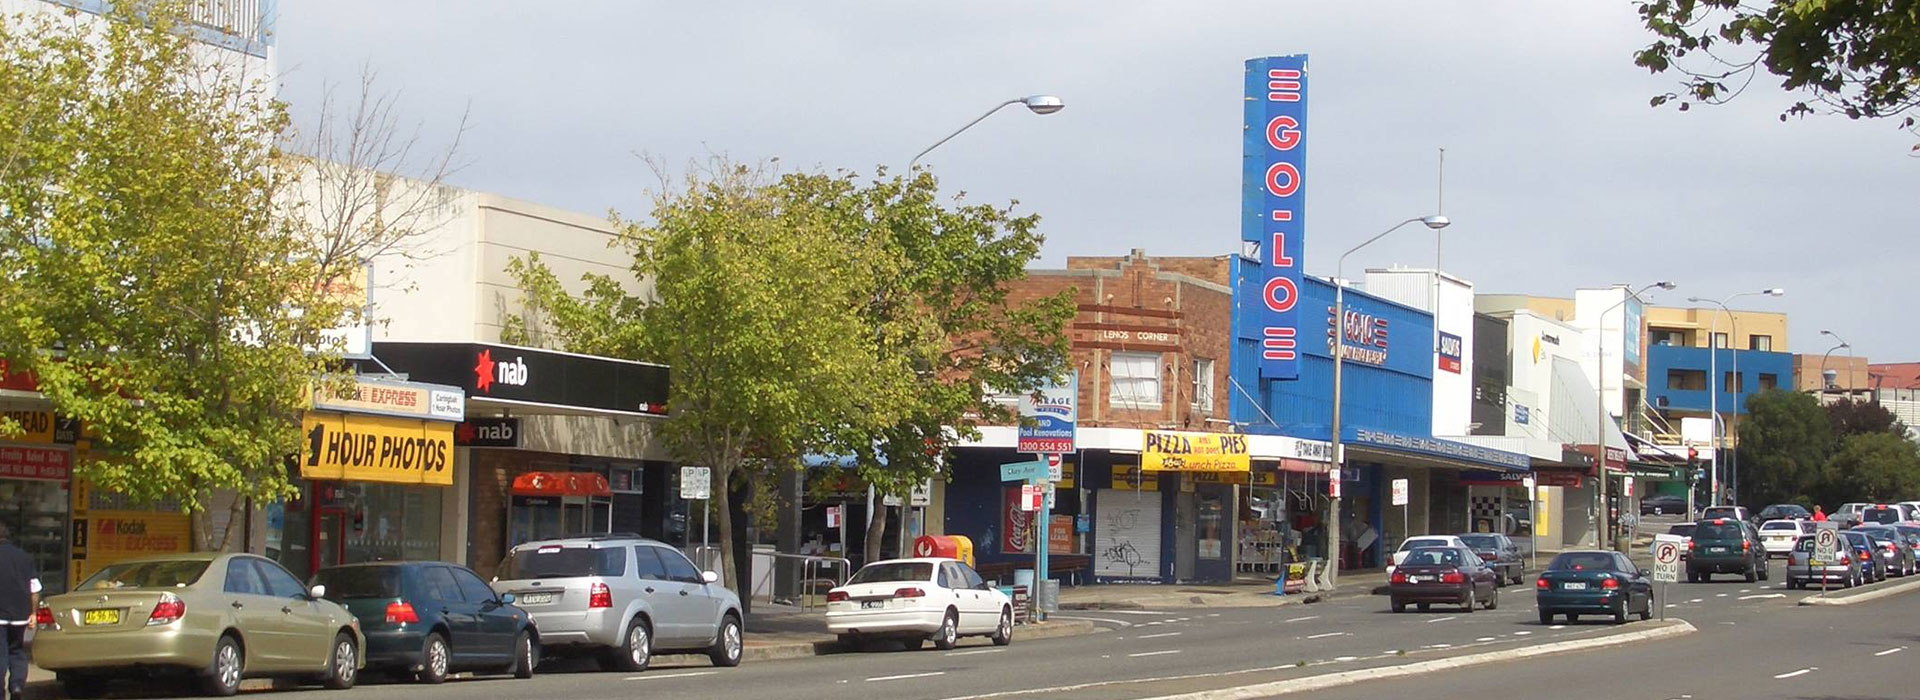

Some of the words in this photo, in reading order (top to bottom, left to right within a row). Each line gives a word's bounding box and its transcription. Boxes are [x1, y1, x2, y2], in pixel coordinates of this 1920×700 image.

[1263, 115, 1301, 312] GO-LO
[1137, 331, 1169, 341] CORNER
[498, 356, 528, 386] nab
[371, 387, 417, 406] EXPRESS
[478, 422, 513, 440] nab
[1020, 427, 1033, 437] Pool
[1034, 429, 1072, 437] Renovations
[307, 423, 324, 467] 1
[326, 431, 377, 467] HOUR
[379, 436, 447, 472] PHOTOS
[1020, 441, 1038, 450] 1300
[1040, 442, 1056, 451] 554
[1057, 442, 1072, 451] 551
[1146, 433, 1192, 454] PIZZA
[1220, 434, 1247, 454] PIES
[1182, 460, 1212, 470] Lunch
[1214, 460, 1237, 469] Pizza
[116, 520, 147, 535] Kodak
[1656, 564, 1668, 572] NO
[1670, 564, 1677, 573] U
[1655, 573, 1676, 581] TURN
